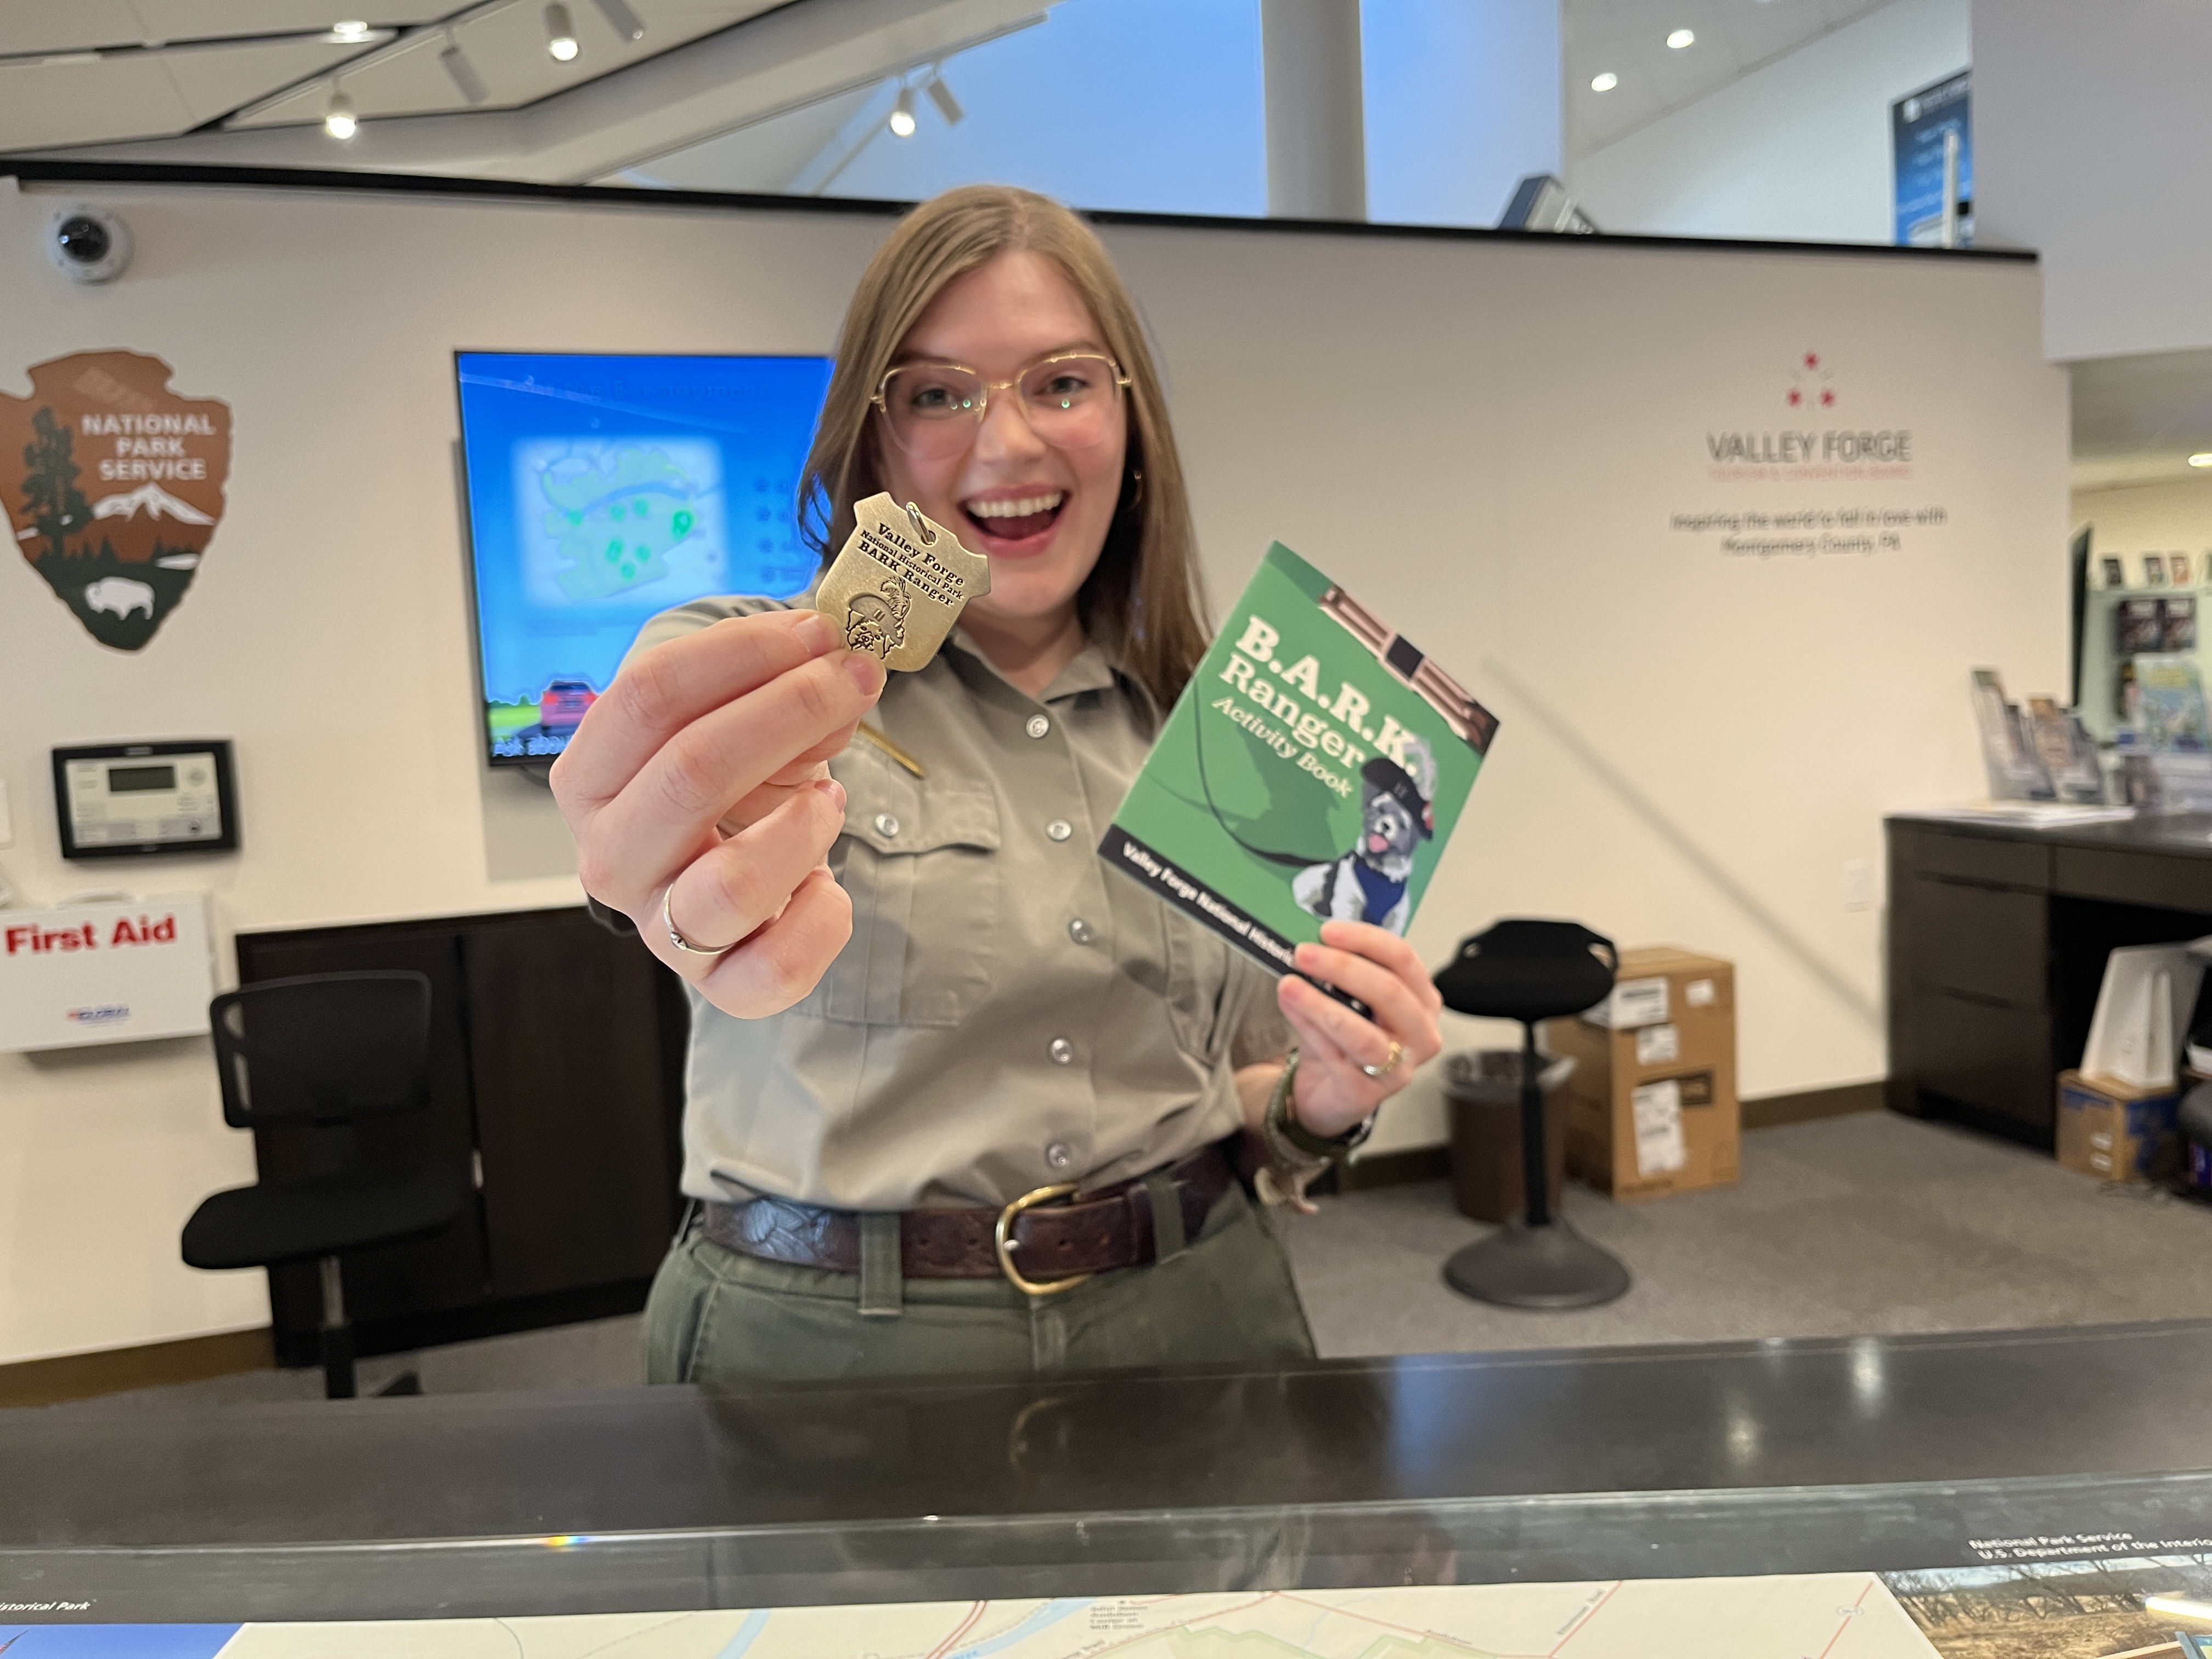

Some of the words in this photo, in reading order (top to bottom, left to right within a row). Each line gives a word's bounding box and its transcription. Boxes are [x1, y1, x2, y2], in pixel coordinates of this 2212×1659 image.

[82, 414, 215, 435] NATIONAL
[116, 438, 185, 457] PARK
[1706, 430, 1816, 462] VALLEY
[1822, 430, 1912, 462] FORGE
[99, 459, 207, 481] SERVICE
[858, 541, 900, 572] BARK
[905, 571, 954, 607] Ranger
[860, 529, 899, 558] National
[900, 554, 941, 585] Historical
[942, 581, 964, 600] Park
[877, 523, 921, 558] Valley
[922, 553, 964, 586] Forge
[1218, 652, 1366, 768] Ranger
[1235, 614, 1417, 777] B.A.R.K.
[1211, 696, 1297, 758] Activity
[1296, 753, 1352, 798] Book
[1124, 842, 1162, 877] Valley
[1160, 867, 1198, 901] Forge
[1196, 891, 1251, 936] National
[1248, 926, 1294, 967] Historic
[5, 922, 97, 955] First
[111, 915, 176, 946] Aid
[1968, 1537, 2038, 1549] National
[2037, 1535, 2075, 1545] Park
[2076, 1532, 2132, 1543] Service
[1978, 1548, 2012, 1559] U.S.
[2012, 1544, 2109, 1558] Department
[2112, 1542, 2129, 1551] of
[2131, 1541, 2159, 1549] the
[2159, 1538, 2212, 1548] Interio
[0, 1601, 57, 1611] istorical
[56, 1601, 91, 1611] Park
